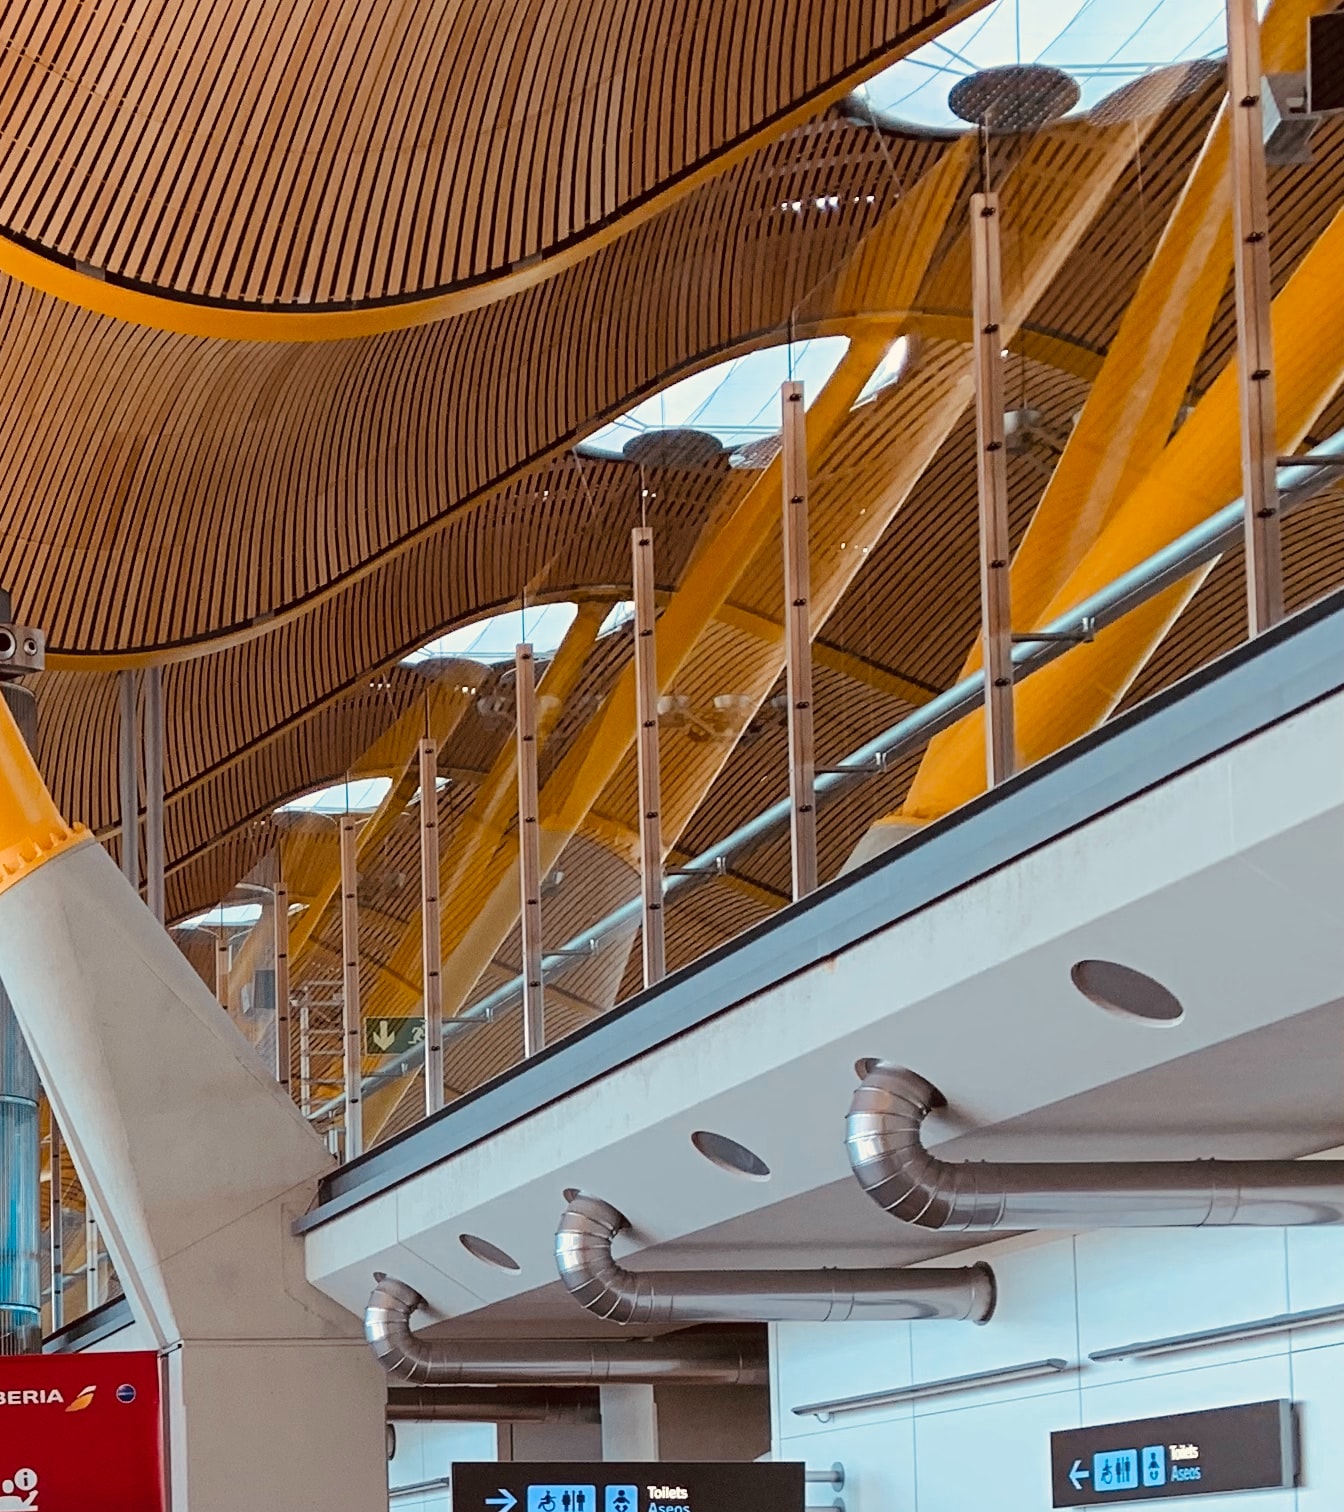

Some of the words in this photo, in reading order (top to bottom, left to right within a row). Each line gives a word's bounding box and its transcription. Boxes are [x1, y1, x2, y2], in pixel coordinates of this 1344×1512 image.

[1168, 1443, 1200, 1461] Toilets
[1170, 1465, 1201, 1482] Aseos
[646, 1485, 689, 1501] Toilets
